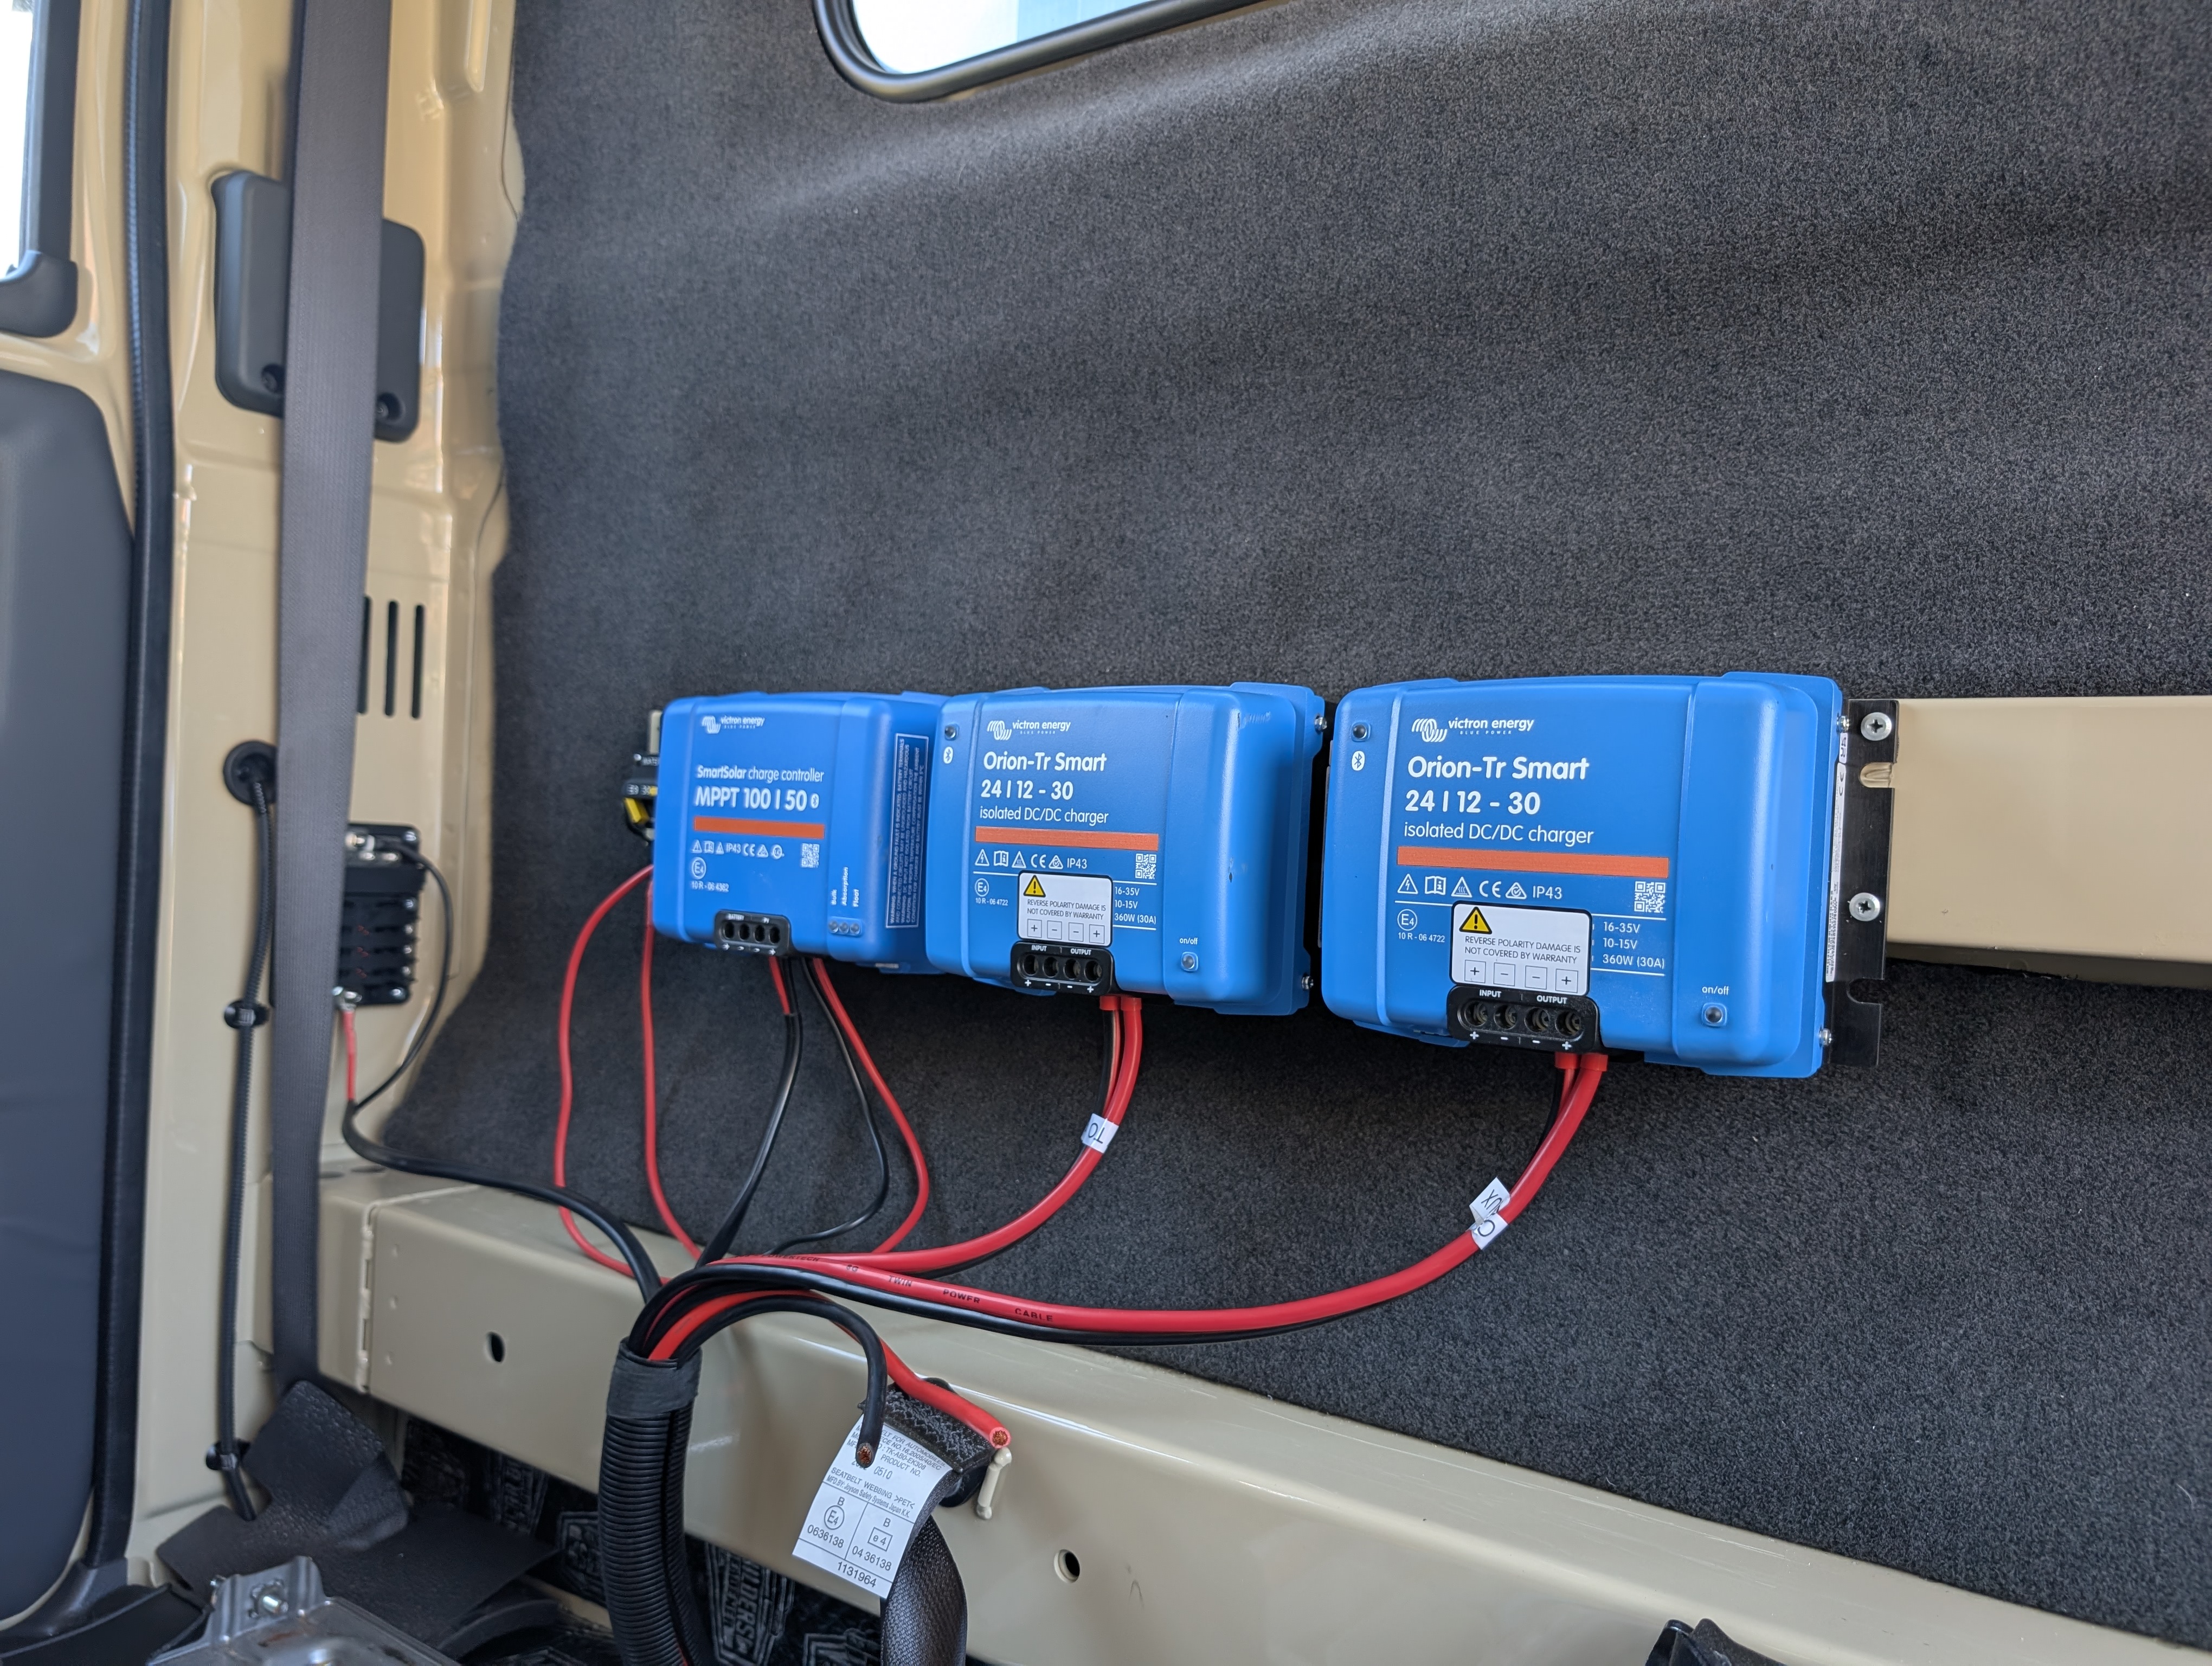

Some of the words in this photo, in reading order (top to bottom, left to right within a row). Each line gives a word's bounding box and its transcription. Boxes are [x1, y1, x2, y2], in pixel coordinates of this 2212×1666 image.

[721, 715, 741, 724] victron
[742, 716, 765, 726] energy
[1012, 720, 1039, 729] victron
[1041, 722, 1071, 732] energy
[1448, 717, 1488, 729] victron
[1491, 719, 1534, 732] energy
[983, 751, 1051, 771] Orion-Tr
[1054, 752, 1107, 771] Smart
[1407, 755, 1507, 778] Orion-Tr
[1512, 757, 1589, 780] Smart
[697, 765, 746, 779] SmartSolar
[748, 766, 779, 784] charge
[781, 767, 824, 782] controller
[981, 779, 1002, 798] 24
[1017, 780, 1033, 798] 12
[1051, 781, 1073, 800] 30
[695, 786, 740, 808] MPPT
[744, 787, 771, 810] 100
[786, 789, 807, 811] 50
[1405, 790, 1435, 812] 24
[1457, 791, 1481, 813] 12
[1508, 792, 1540, 815] 30
[980, 805, 1021, 819] isolated
[1024, 808, 1062, 822] DC/DC
[1064, 808, 1109, 826] charger
[1404, 821, 1464, 838] isolated
[1469, 824, 1523, 841] DC/DC
[1528, 825, 1594, 847] charger
[726, 843, 741, 854] IP43
[1067, 858, 1088, 869] IP43
[1115, 886, 1140, 896] 16-35V
[1533, 885, 1563, 900] IP43
[1050, 901, 1075, 909] POLARITY
[1075, 902, 1100, 911] DAMAGE
[1115, 900, 1138, 909] 10-15V
[1040, 909, 1064, 917] COVERED
[1073, 912, 1104, 920] WARRANTY
[1115, 914, 1135, 922] 360W
[1137, 915, 1156, 925] (30A)
[1603, 921, 1640, 934] 16-35V
[1179, 937, 1198, 946] on/off
[1398, 932, 1406, 940] 10
[1407, 932, 1413, 940] R
[1418, 933, 1427, 941] 06
[1428, 934, 1445, 943] 4722
[1465, 936, 1496, 946] REVERSE
[1498, 938, 1534, 949] POLARITY
[1536, 941, 1572, 953] DAMAGE
[1574, 945, 1581, 953] IS
[1603, 938, 1637, 950] 10-15V
[1070, 948, 1091, 956] OUTPUT
[1464, 947, 1481, 956] NOT
[1483, 947, 1519, 959] COVERED
[1520, 951, 1531, 959] BY
[1532, 951, 1577, 964] WARRANTY
[1602, 954, 1633, 966] 360W
[1637, 956, 1665, 970] (30A)
[1479, 989, 1502, 998] INPUT
[1536, 995, 1567, 1004] OUTPUT
[1701, 984, 1729, 996] on/off
[889, 1276, 912, 1287] TWIN
[943, 1289, 981, 1304] POWER
[1014, 1308, 1053, 1322] CABLE
[892, 1436, 905, 1444] FOR
[874, 1466, 892, 1479] 0510
[880, 1454, 910, 1471] PRODUCT
[910, 1467, 921, 1477] NO.
[831, 1467, 862, 1484] SEATBELT
[864, 1481, 892, 1499] WEBBING
[837, 1496, 845, 1506] B
[844, 1483, 858, 1494] Joyson
[859, 1489, 872, 1500] Safety
[872, 1495, 889, 1508] Systems
[889, 1503, 901, 1513] Japan
[883, 1517, 891, 1527] B
[807, 1524, 844, 1548] 0636138
[864, 1552, 892, 1571] 36138
[838, 1561, 877, 1587] 1131964
